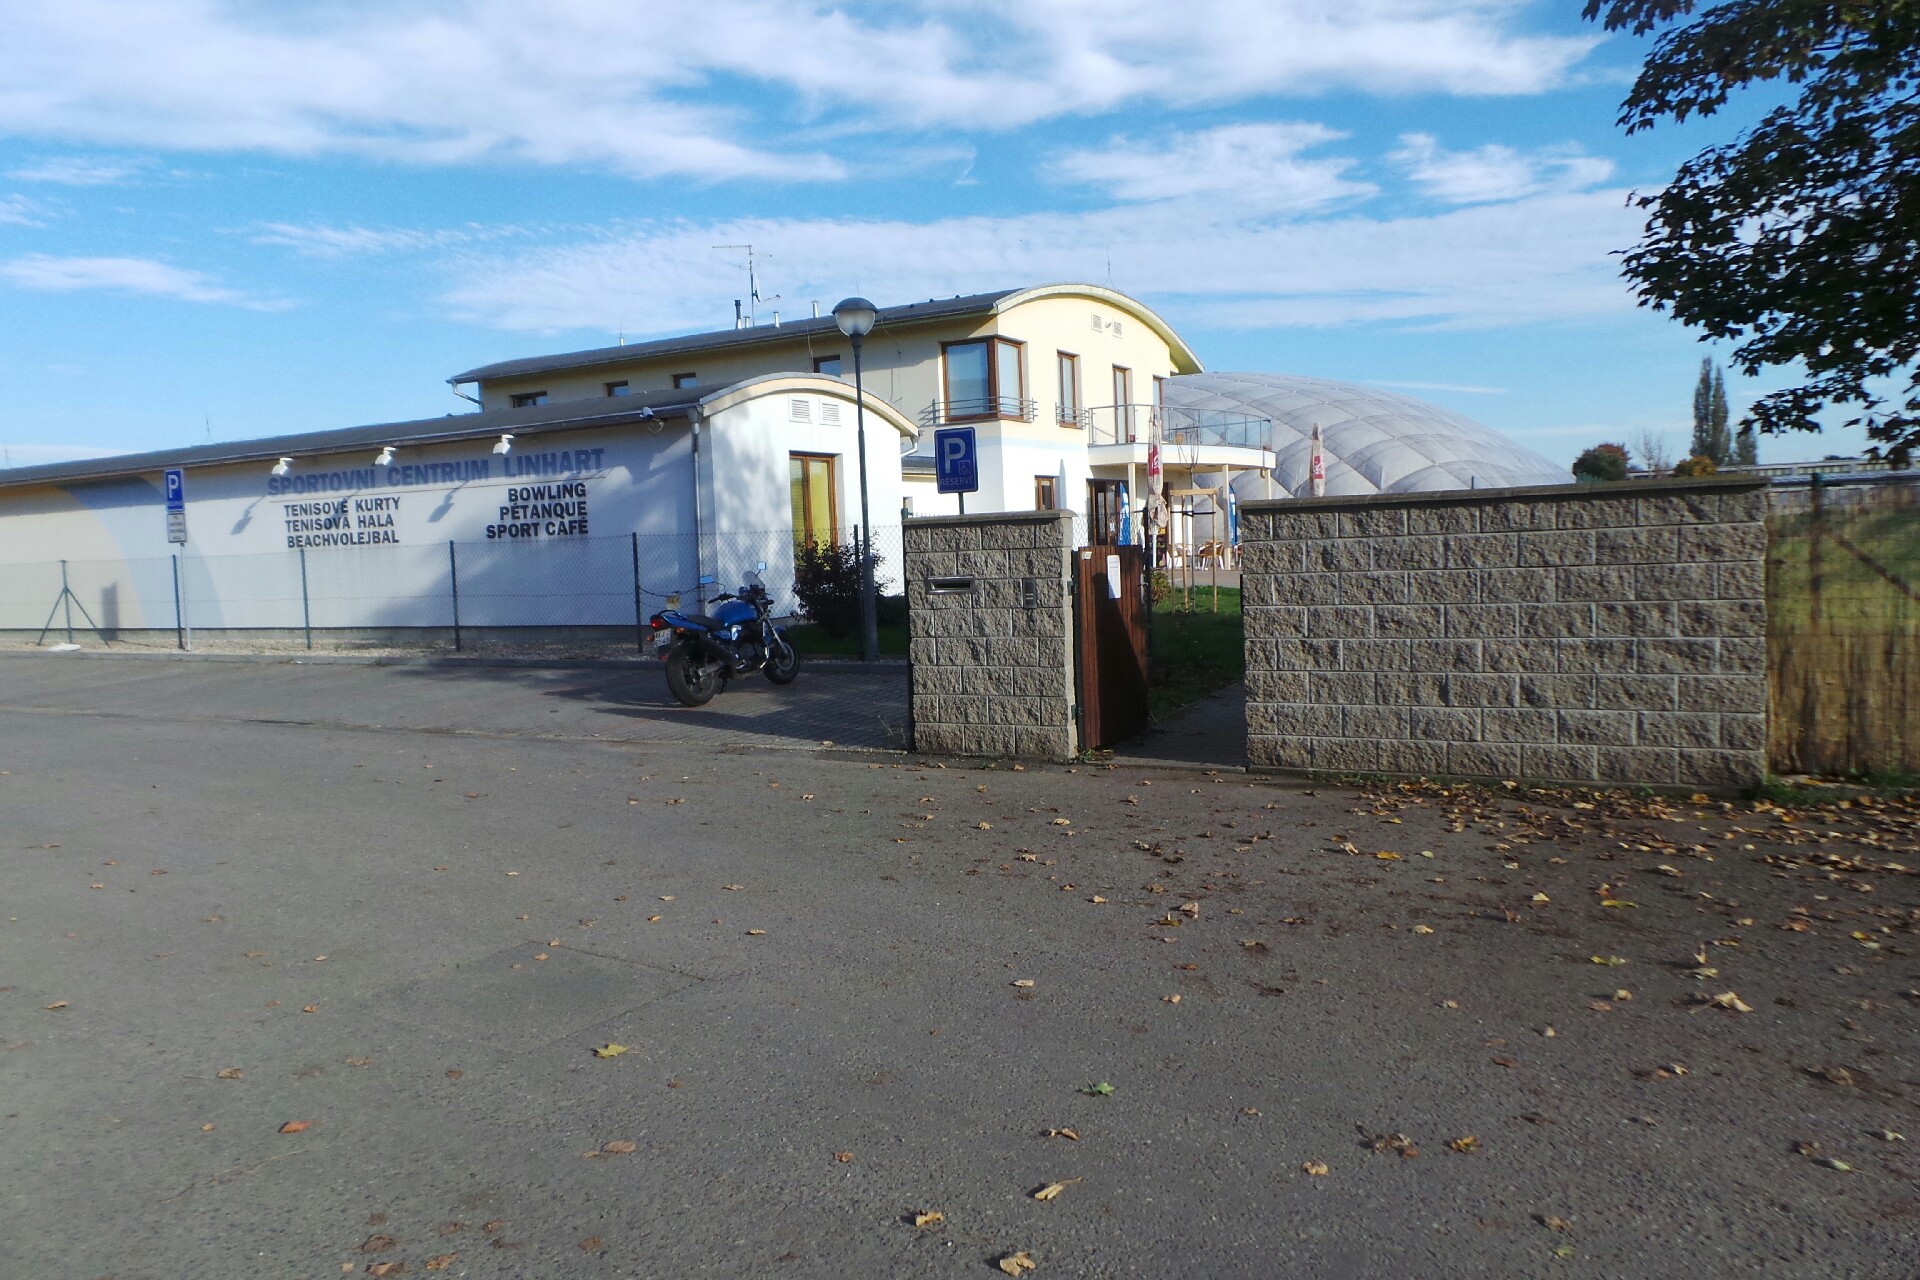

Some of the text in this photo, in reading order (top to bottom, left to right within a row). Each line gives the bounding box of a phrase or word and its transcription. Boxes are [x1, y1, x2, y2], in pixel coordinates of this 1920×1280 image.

[944, 437, 966, 474] P
[386, 459, 489, 487] CENTRUM
[503, 448, 605, 478] LINHART
[167, 474, 179, 499] P
[508, 482, 587, 502] BOWLING
[283, 496, 400, 517] TENISOVÉ KURTY
[499, 501, 587, 520] PÉTANQUE
[285, 513, 394, 533] TENISOVÁ HALA
[486, 516, 589, 539] SPORT CAFÉ
[287, 530, 400, 548] BEACHVOLEJBAL
